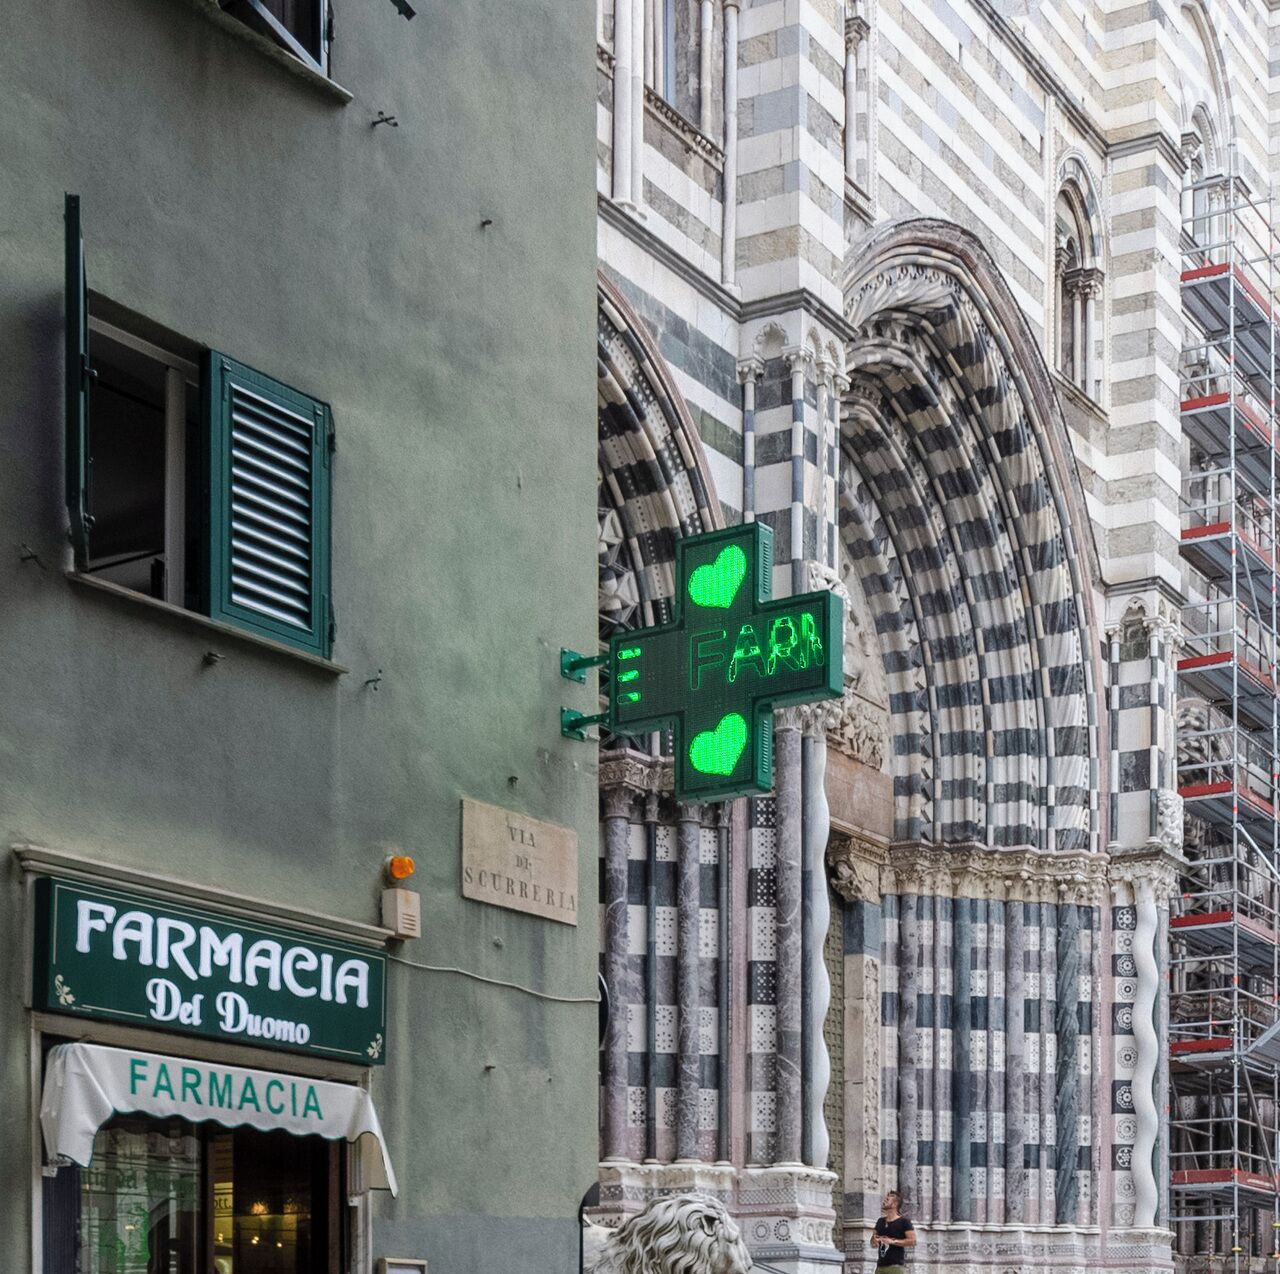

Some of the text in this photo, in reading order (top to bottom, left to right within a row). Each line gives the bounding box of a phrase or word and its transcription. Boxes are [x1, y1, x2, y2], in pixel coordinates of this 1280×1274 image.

[507, 825, 537, 848] VIA
[463, 865, 577, 912] SCURRERIA
[75, 899, 370, 1009] FARMACIA
[145, 977, 311, 1045] Del Duomo
[129, 1058, 324, 1121] FARMACIA
